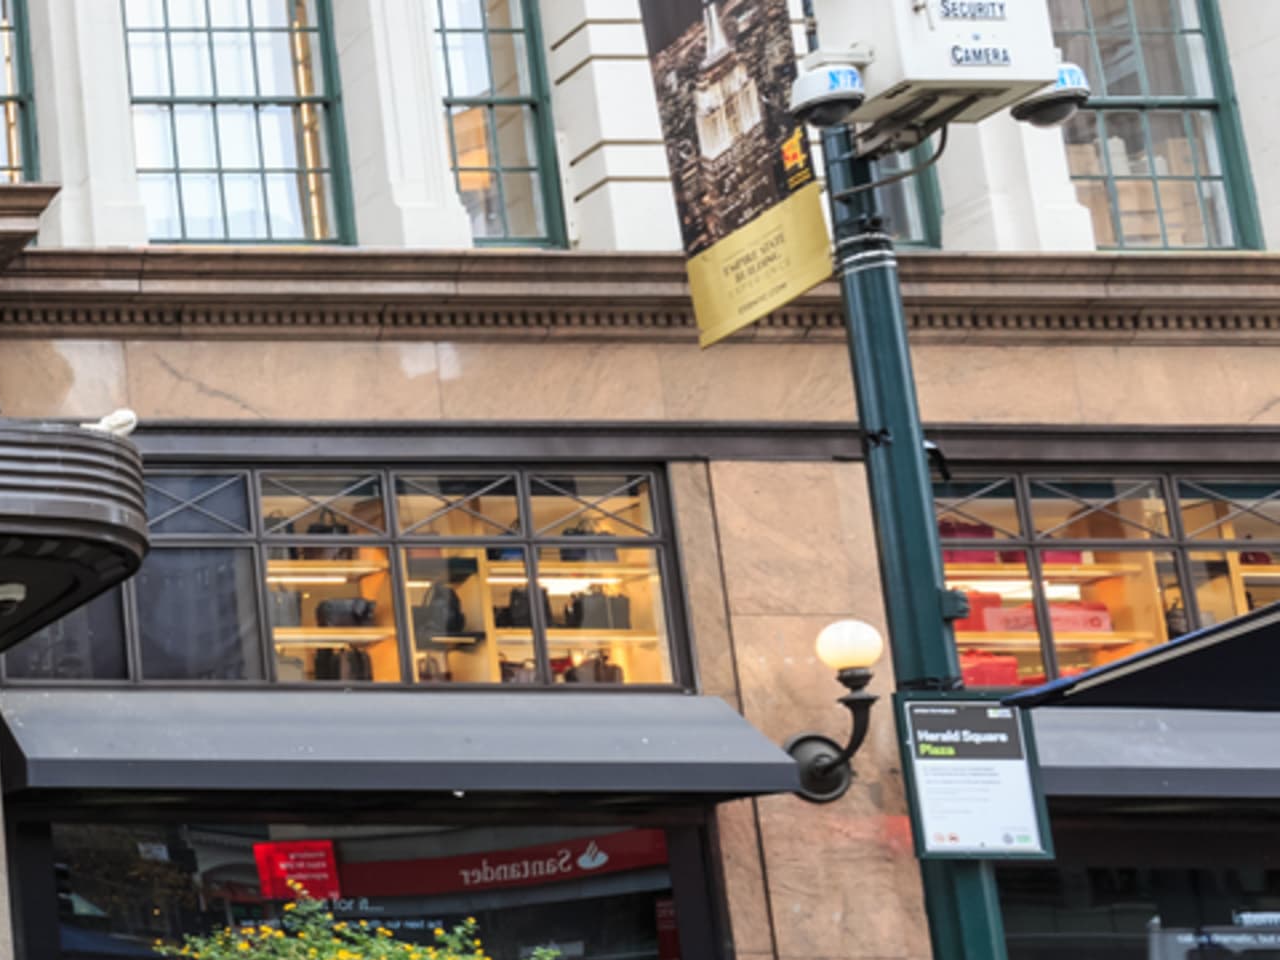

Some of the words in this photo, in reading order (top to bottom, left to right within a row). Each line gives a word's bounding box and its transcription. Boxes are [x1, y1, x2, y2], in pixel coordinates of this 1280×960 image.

[941, 0, 1007, 19] SECURITY
[951, 45, 1011, 64] CAMERA
[916, 729, 961, 743] Herald
[962, 729, 1009, 744] Square
[919, 743, 956, 756] Plaza
